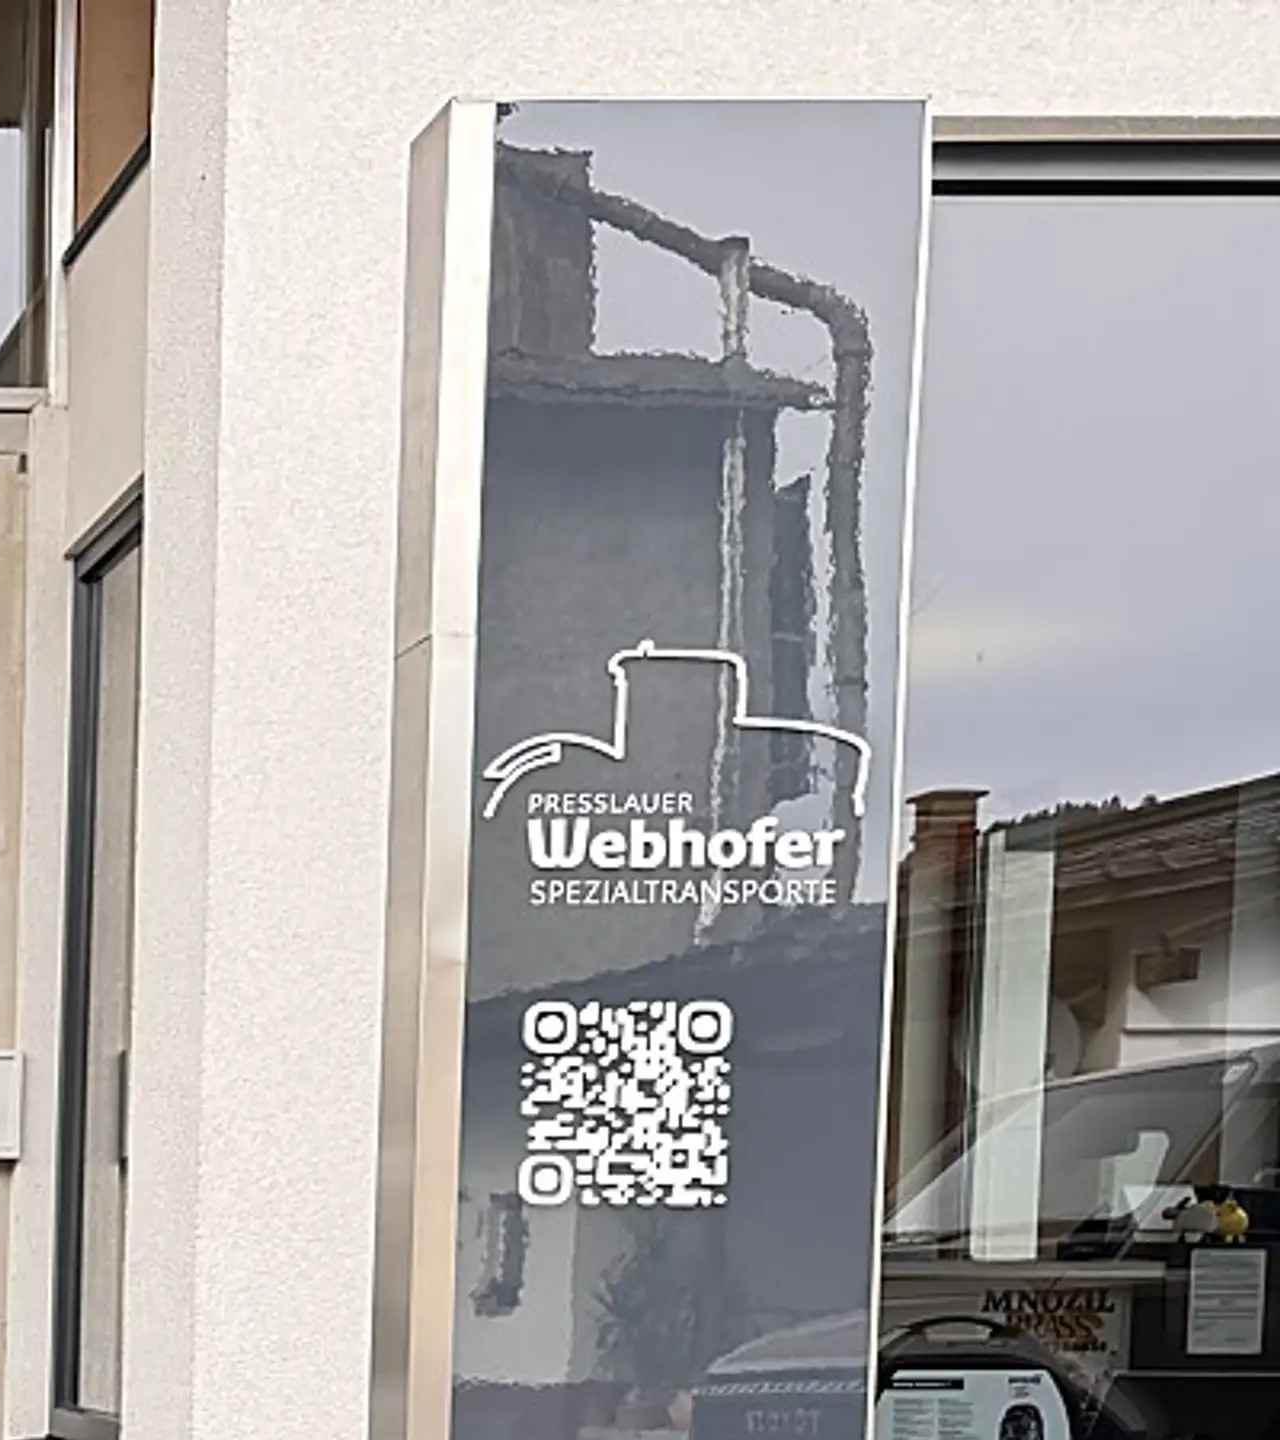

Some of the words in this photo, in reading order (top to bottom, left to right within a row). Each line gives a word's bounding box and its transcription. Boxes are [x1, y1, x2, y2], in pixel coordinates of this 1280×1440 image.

[527, 792, 693, 815] PRESSLAUER
[526, 815, 847, 870] Webhofer
[529, 879, 838, 905] SPEZIALTRANSPORTE
